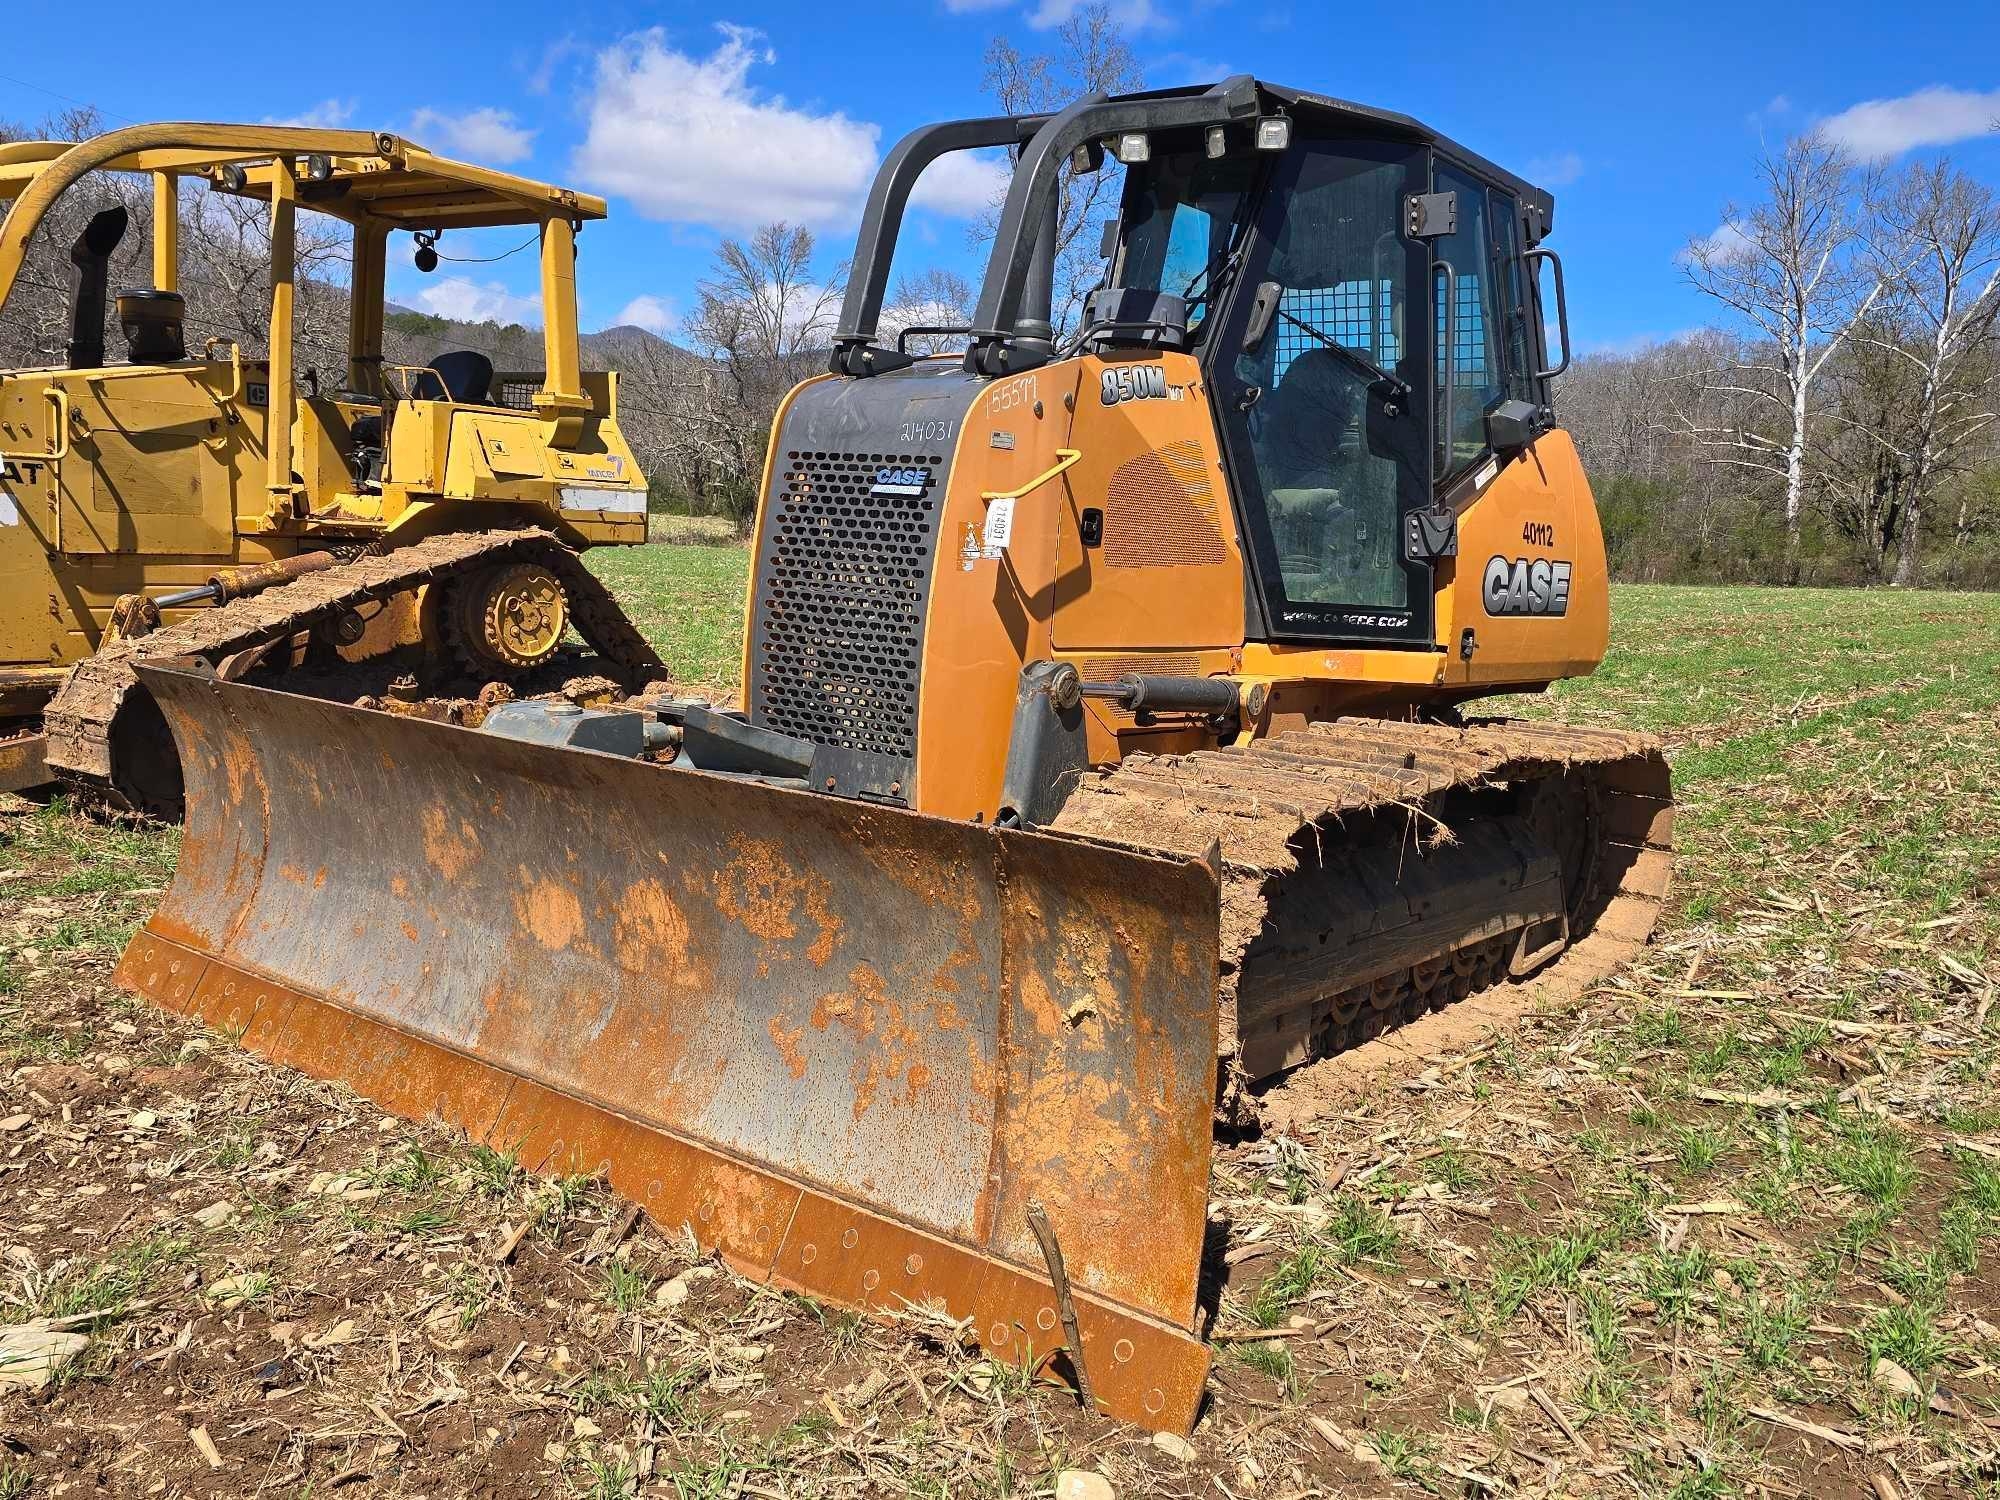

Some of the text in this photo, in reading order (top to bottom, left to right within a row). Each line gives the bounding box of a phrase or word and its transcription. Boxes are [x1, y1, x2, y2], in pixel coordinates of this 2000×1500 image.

[1101, 365, 1167, 405] 850M
[900, 420, 953, 441] 214031
[876, 468, 928, 486] CASE
[993, 506, 1008, 540] 214031
[1522, 521, 1554, 547] 40112
[1483, 555, 1571, 616] CASE
